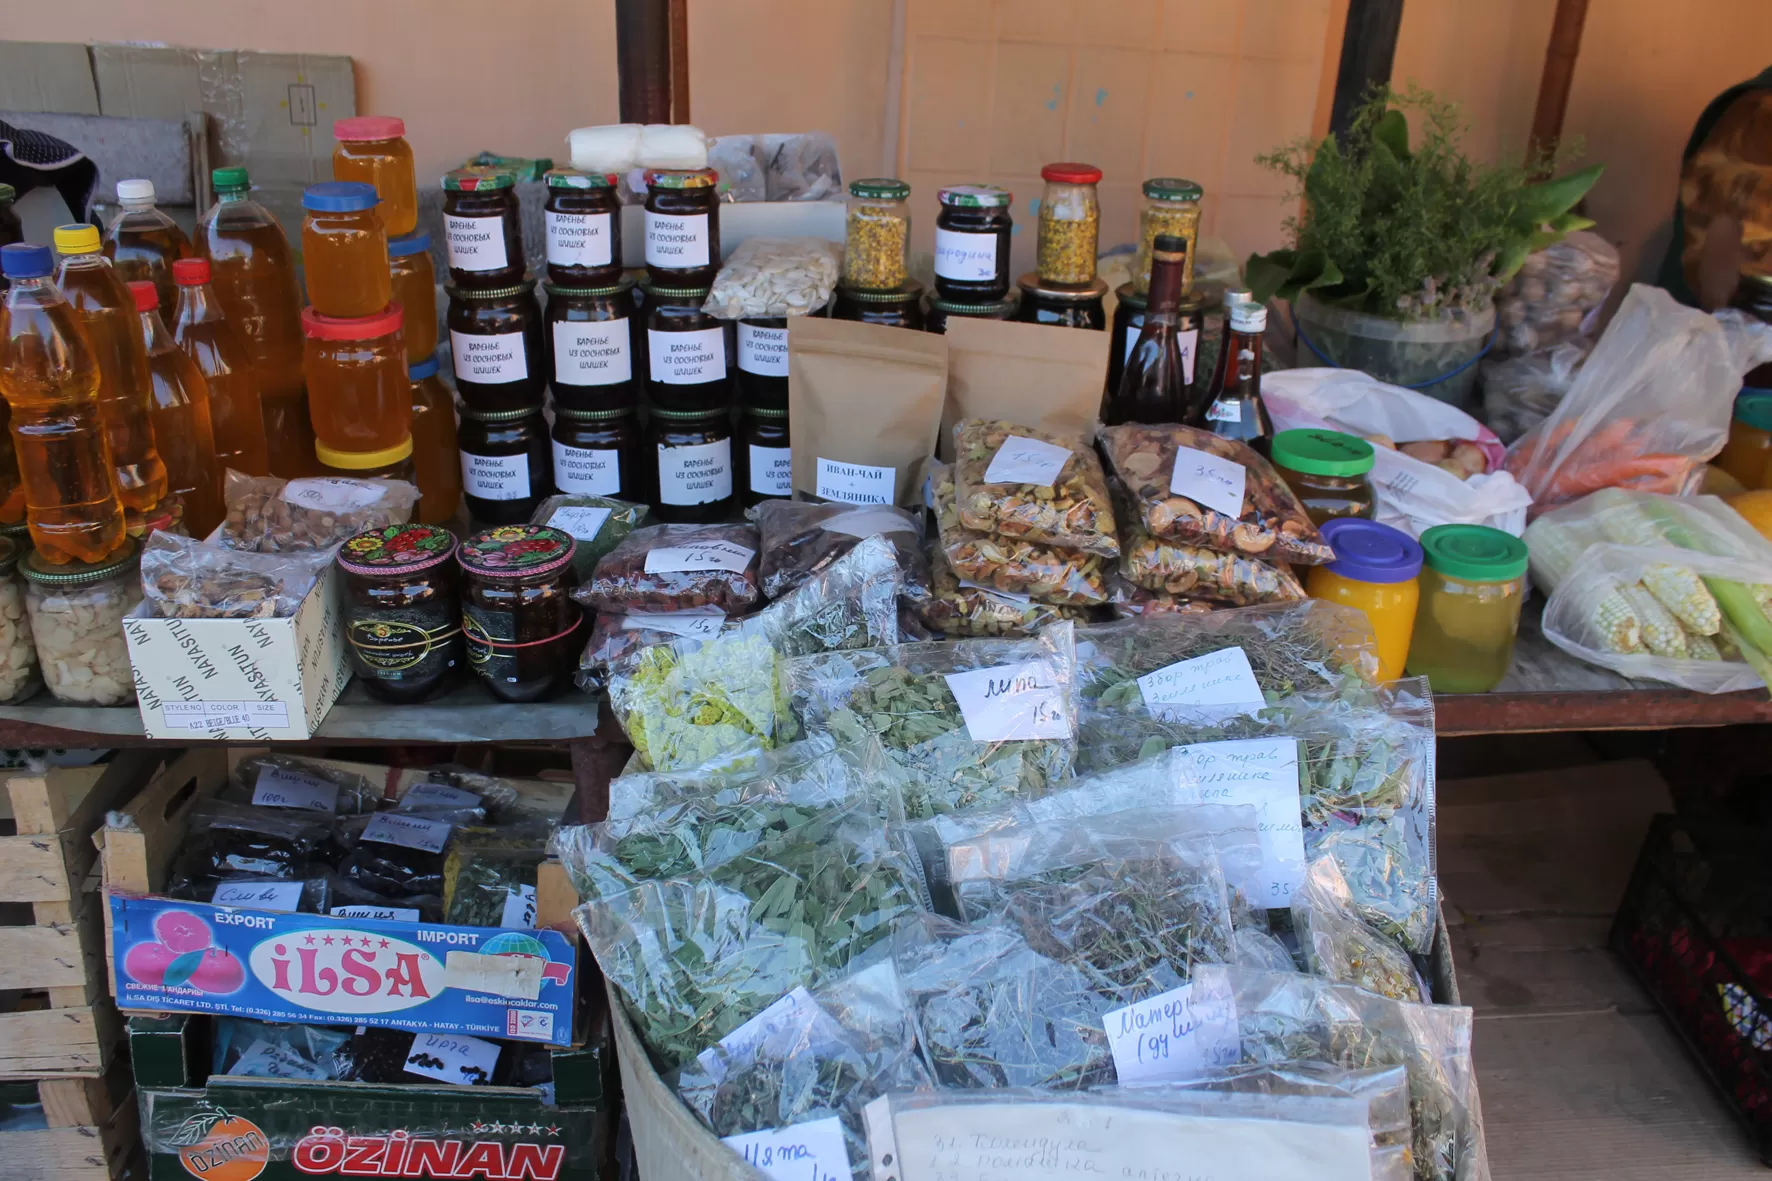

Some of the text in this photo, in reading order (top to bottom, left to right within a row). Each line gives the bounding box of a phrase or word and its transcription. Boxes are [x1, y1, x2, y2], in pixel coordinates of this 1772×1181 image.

[826, 464, 882, 479] ИВАН-ЧАЙ
[821, 487, 887, 504] ЗЕМЛЯНИКА
[215, 912, 276, 930] EXPORT
[417, 930, 480, 946] IMPORT
[369, 1017, 379, 1025] 52
[391, 1019, 428, 1028] ANTAKYA
[433, 1022, 460, 1030] HATAY
